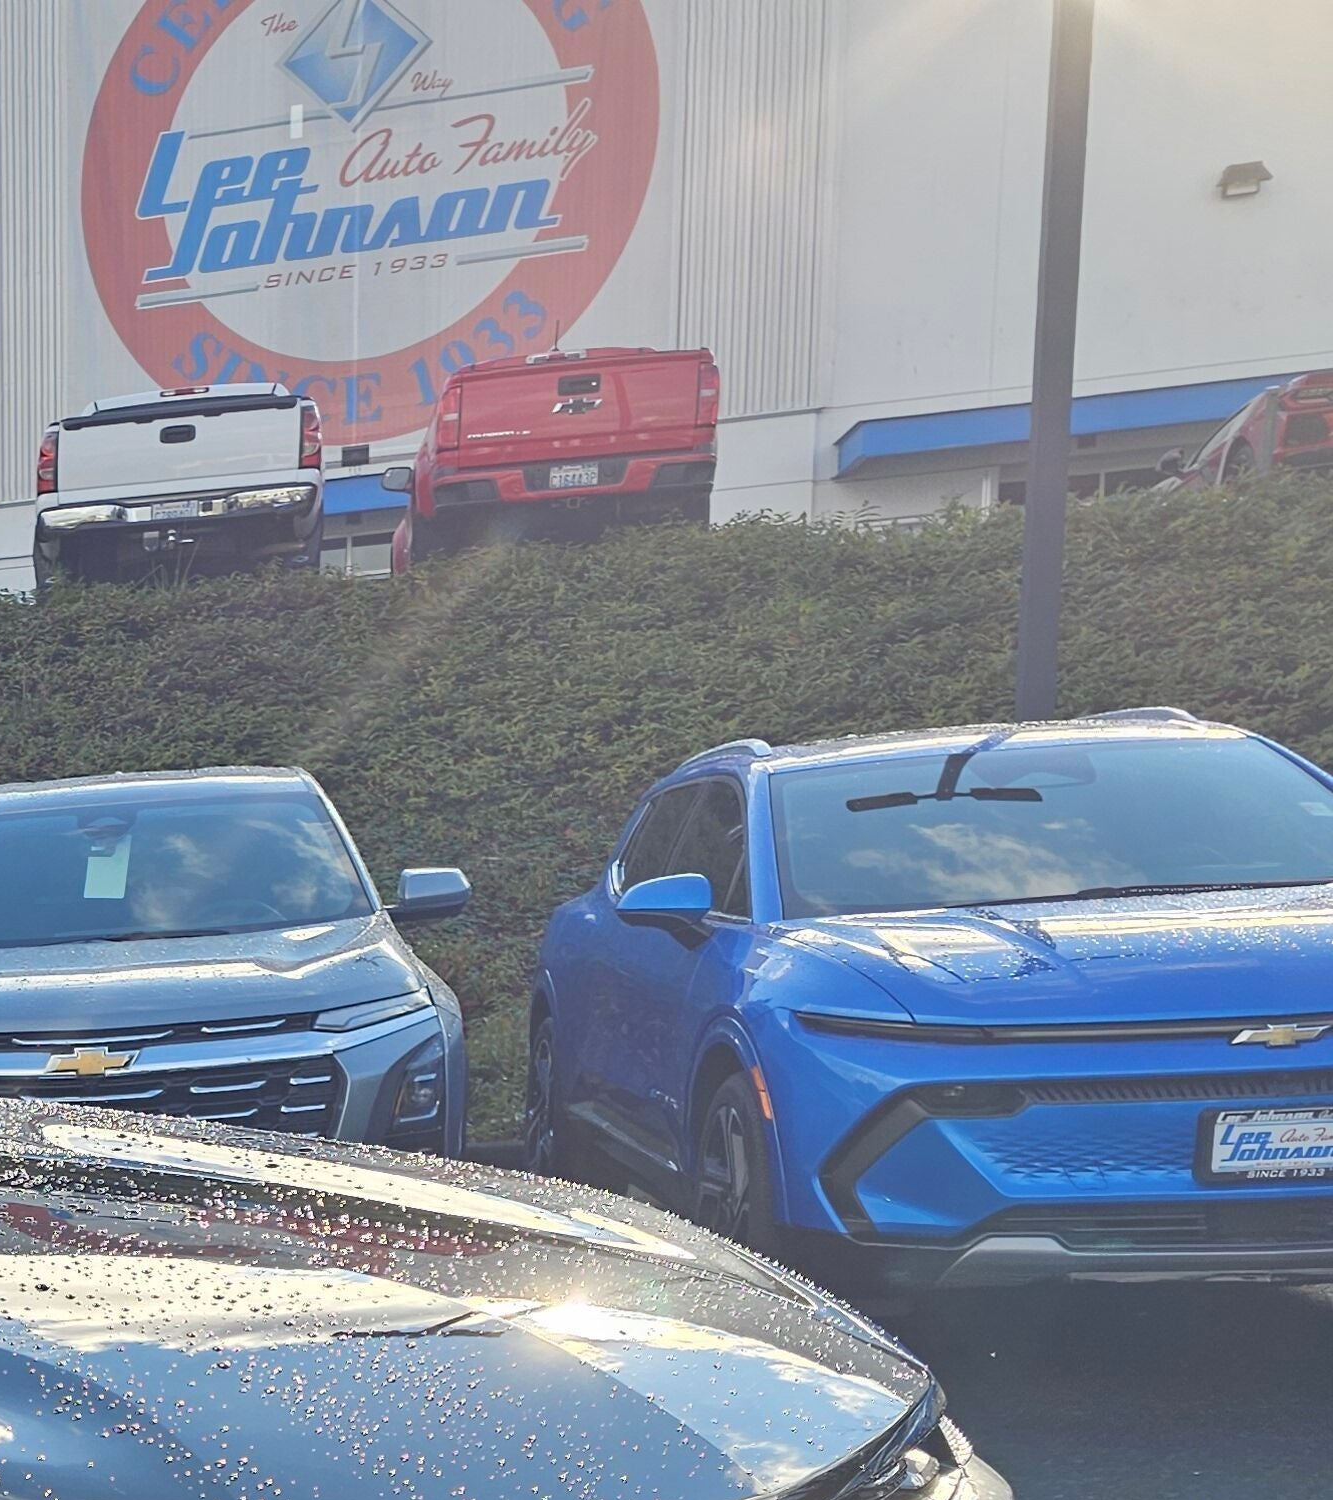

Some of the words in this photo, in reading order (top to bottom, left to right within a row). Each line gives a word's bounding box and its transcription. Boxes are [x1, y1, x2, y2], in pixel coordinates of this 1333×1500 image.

[261, 13, 299, 36] The
[411, 70, 453, 98] Way
[137, 130, 311, 216] Lee
[339, 128, 442, 187] Auto
[450, 98, 595, 178] Family
[144, 178, 561, 281] Johnson
[264, 264, 357, 288] SINCE
[374, 253, 449, 276] 1933
[1248, 1109, 1314, 1122] Johnson
[1220, 1124, 1271, 1145] Lee
[1280, 1128, 1309, 1143] Auto
[1247, 1169, 1287, 1178] SINCE
[1293, 1168, 1325, 1177] 1933
